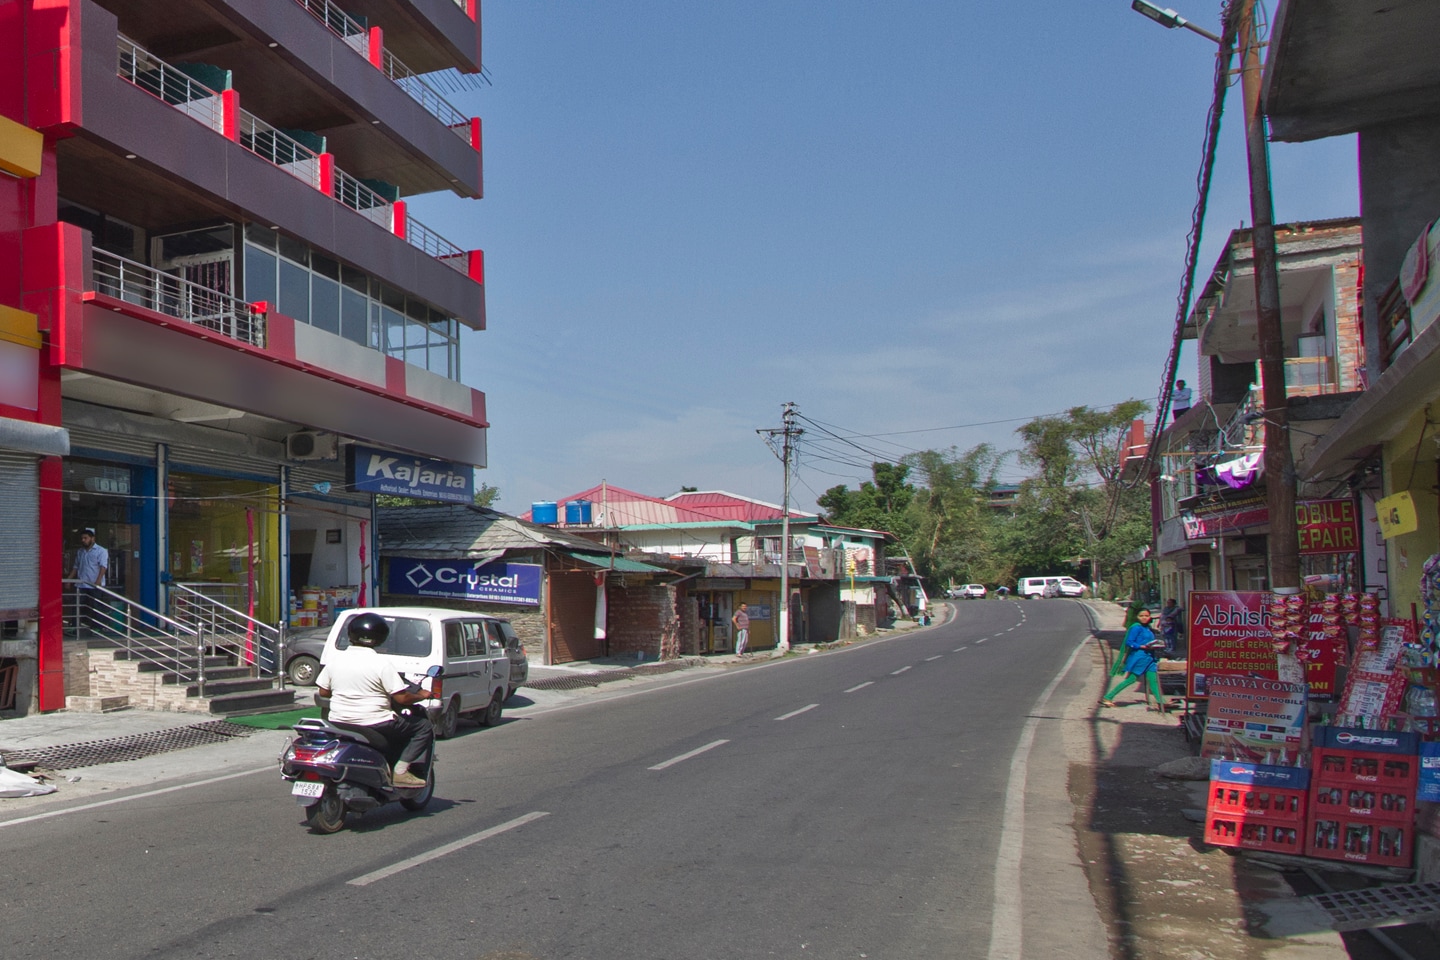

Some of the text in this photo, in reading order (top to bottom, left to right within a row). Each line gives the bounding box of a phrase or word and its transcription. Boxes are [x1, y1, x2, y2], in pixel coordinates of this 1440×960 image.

[366, 454, 466, 488] Kajaria
[1295, 501, 1353, 525] OBILE
[1297, 526, 1354, 550] EPAIR
[435, 567, 518, 590] Crystal
[479, 586, 517, 594] CERAMICS
[1193, 604, 1273, 626] Abhish
[1202, 628, 1273, 638] COMMUNICA
[1214, 640, 1274, 649] MOBILE REPAI
[1206, 650, 1278, 660] MOBILE RECHAR
[1193, 661, 1279, 671] MOBILE ACCESSORIE
[1212, 676, 1258, 689] KAVYA
[1270, 697, 1305, 706] MOBILE
[1219, 707, 1292, 720] DISH RECHARGE
[1349, 735, 1398, 745] PEPSI
